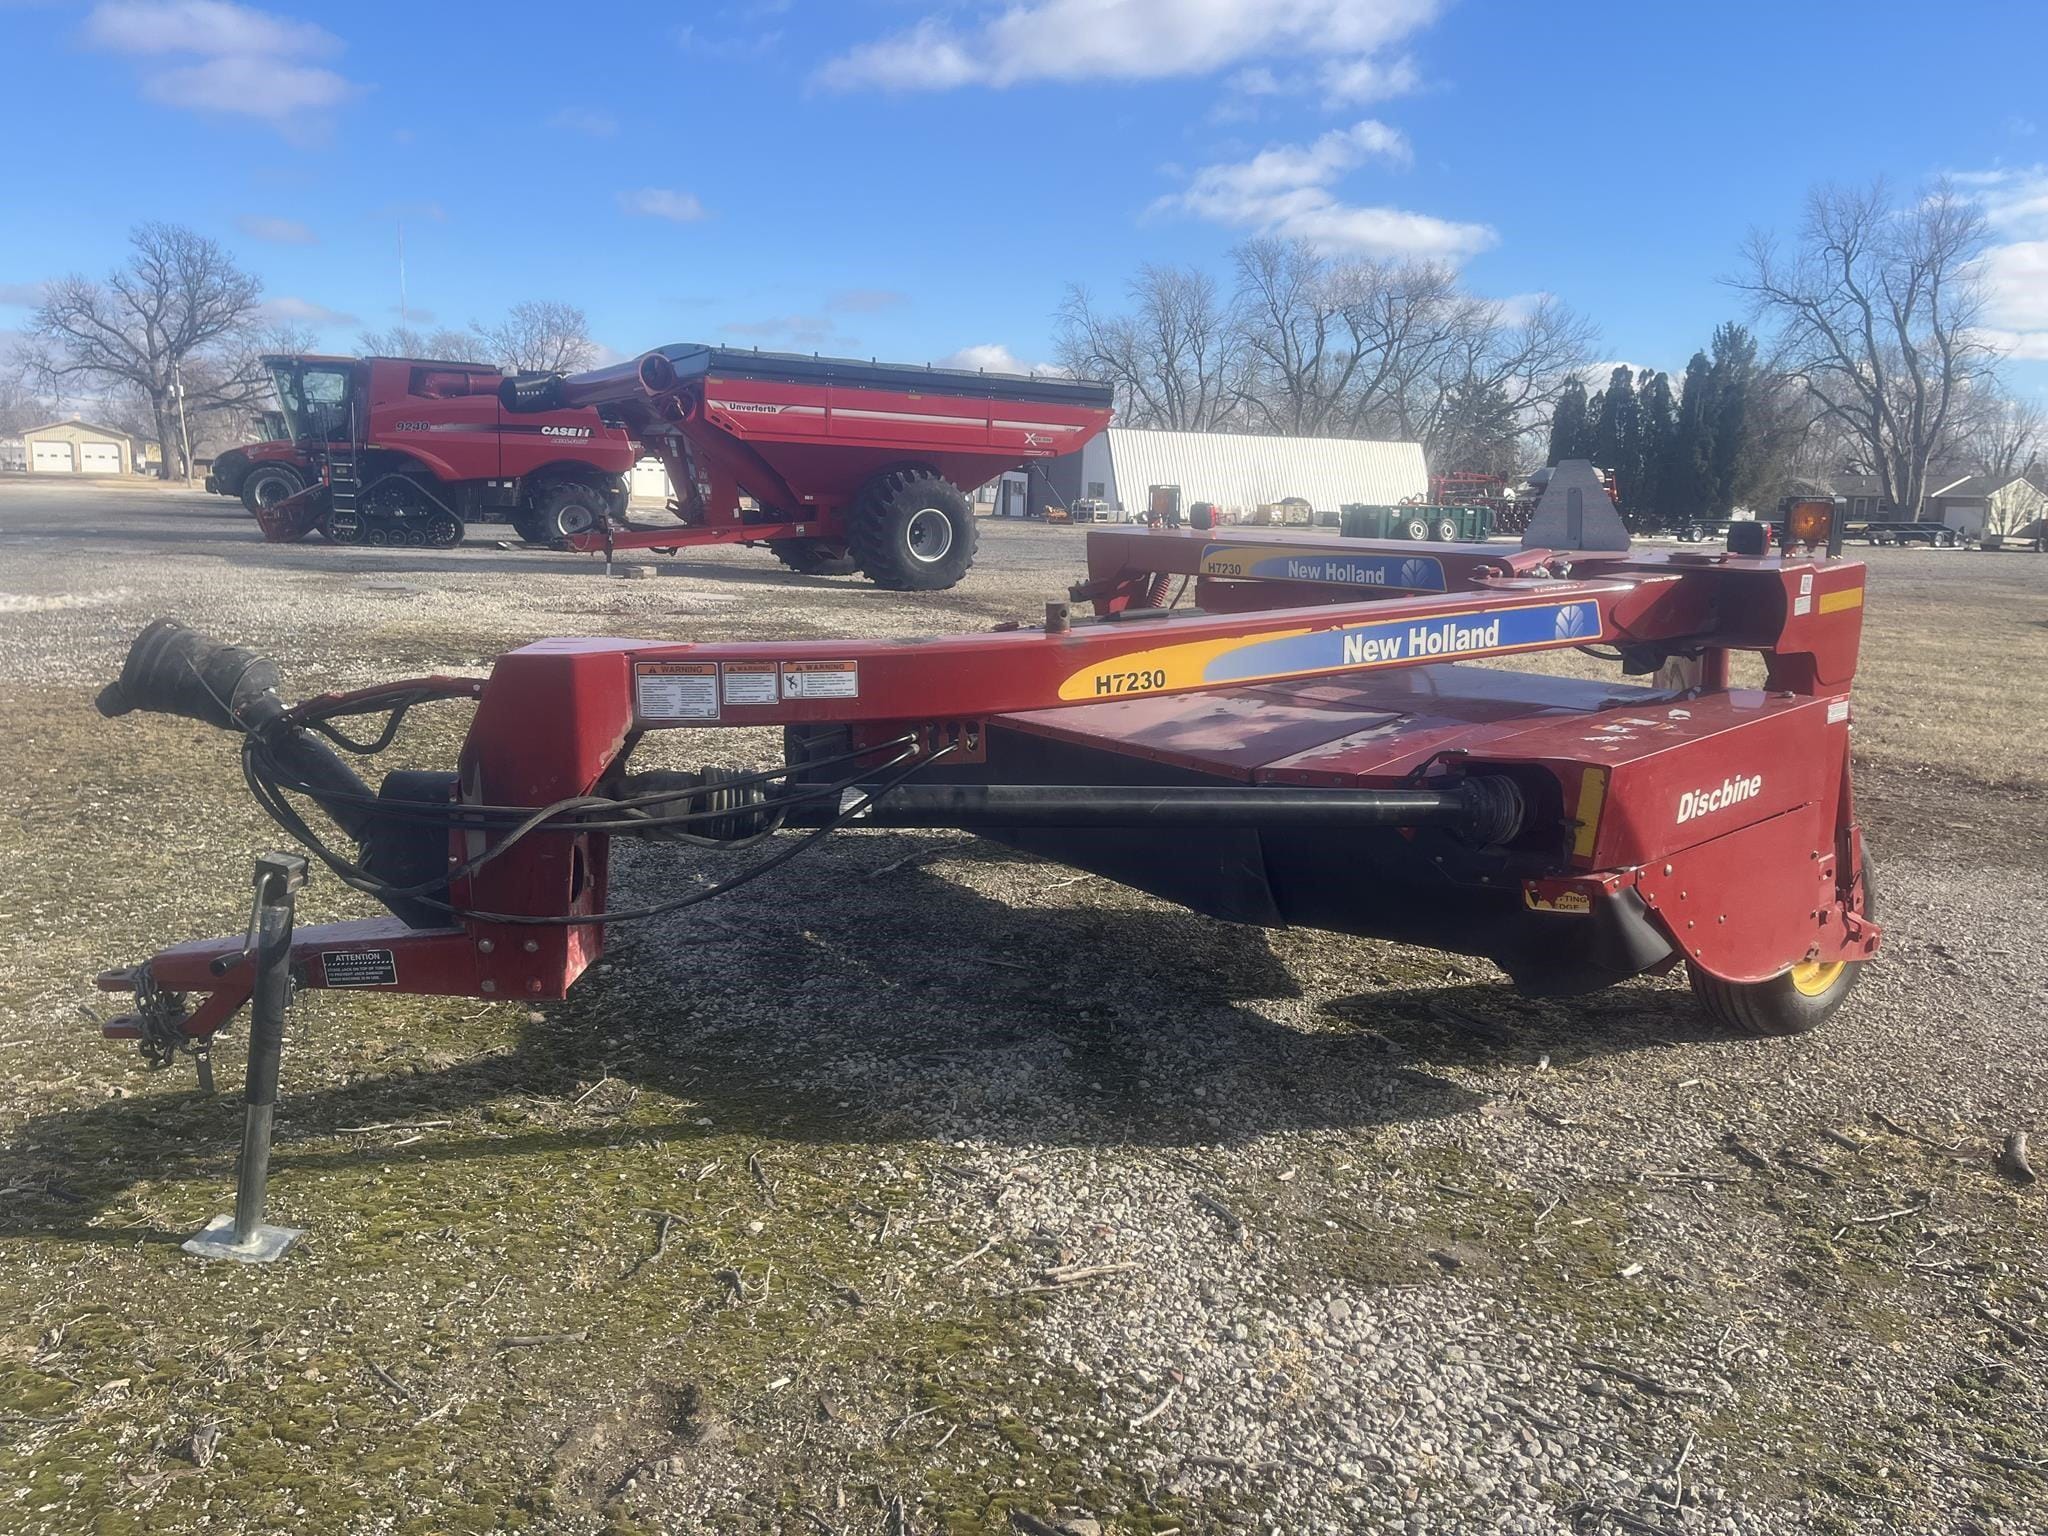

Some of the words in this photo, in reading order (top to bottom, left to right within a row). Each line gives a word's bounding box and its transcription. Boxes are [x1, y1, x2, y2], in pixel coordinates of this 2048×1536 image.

[396, 421, 429, 432] 9240
[541, 426, 577, 436] CASE
[1208, 562, 1242, 575] H7230
[1288, 560, 1320, 580] New
[1326, 561, 1385, 585] Holland
[1095, 669, 1166, 695] H7230
[1343, 632, 1402, 665] New
[1408, 619, 1499, 657] Holland
[661, 666, 703, 674] WARNING
[805, 663, 845, 671] WARNING
[1676, 774, 1762, 824] Discbine
[335, 953, 381, 962] ATTENTION
